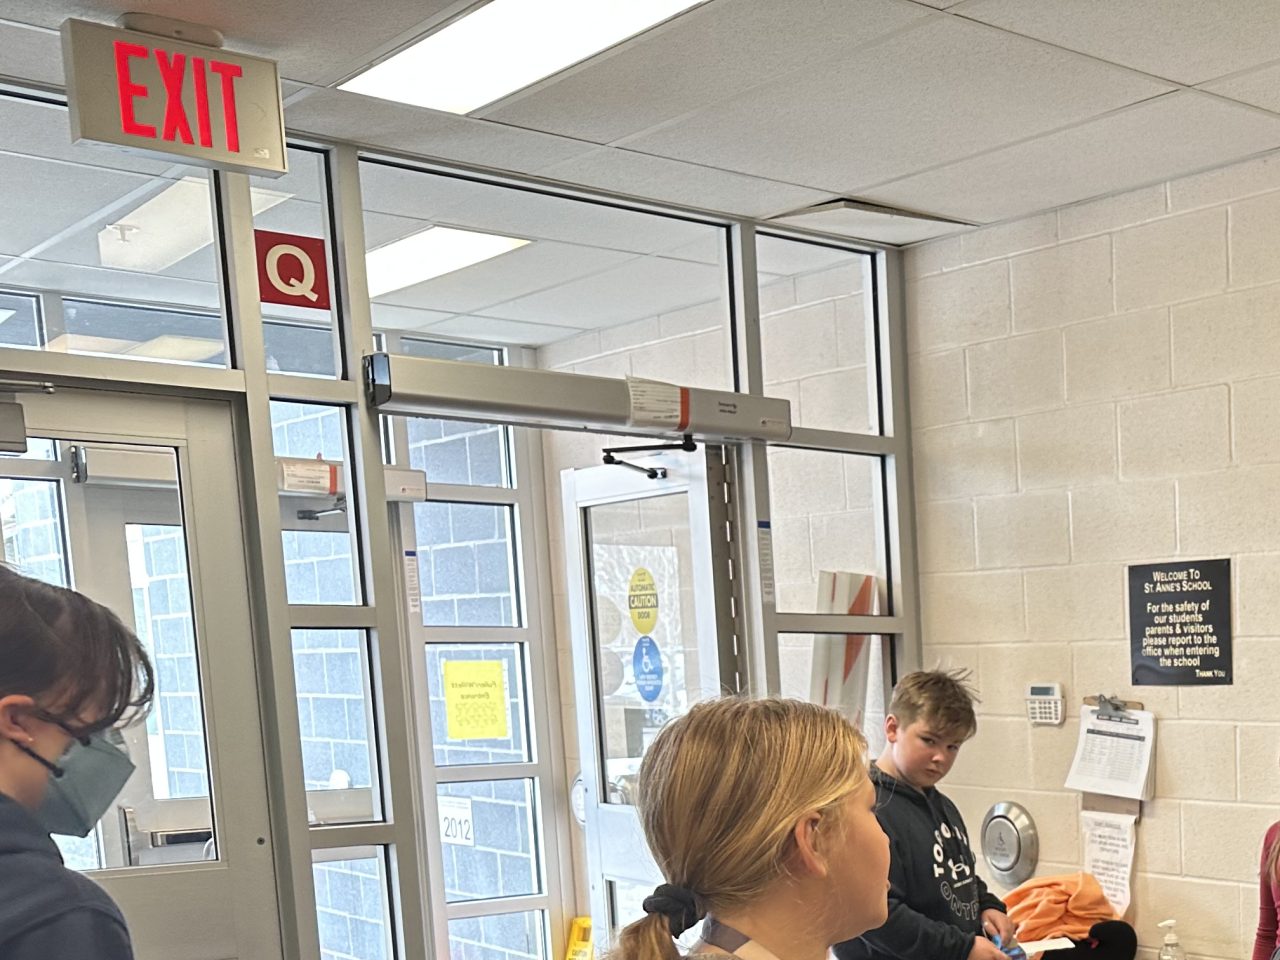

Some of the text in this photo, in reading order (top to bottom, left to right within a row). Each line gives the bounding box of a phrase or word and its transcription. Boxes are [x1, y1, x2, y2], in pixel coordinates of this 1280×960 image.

[114, 40, 243, 153] EXIT
[265, 243, 319, 302] Q
[1153, 571, 1188, 581] WELCOME
[630, 583, 655, 593] AUTOMATIC
[1156, 582, 1180, 593] ANNE'S
[1182, 581, 1212, 591] SCHOOL
[630, 595, 657, 608] CAUTION
[1147, 600, 1210, 614] For the safety of
[1154, 613, 1203, 624] our students
[1145, 623, 1213, 637] parents & visitors
[1142, 634, 1217, 647] please report to the
[1141, 645, 1219, 657] office when entering
[1160, 657, 1200, 667] the school
[444, 816, 471, 841] 2012
